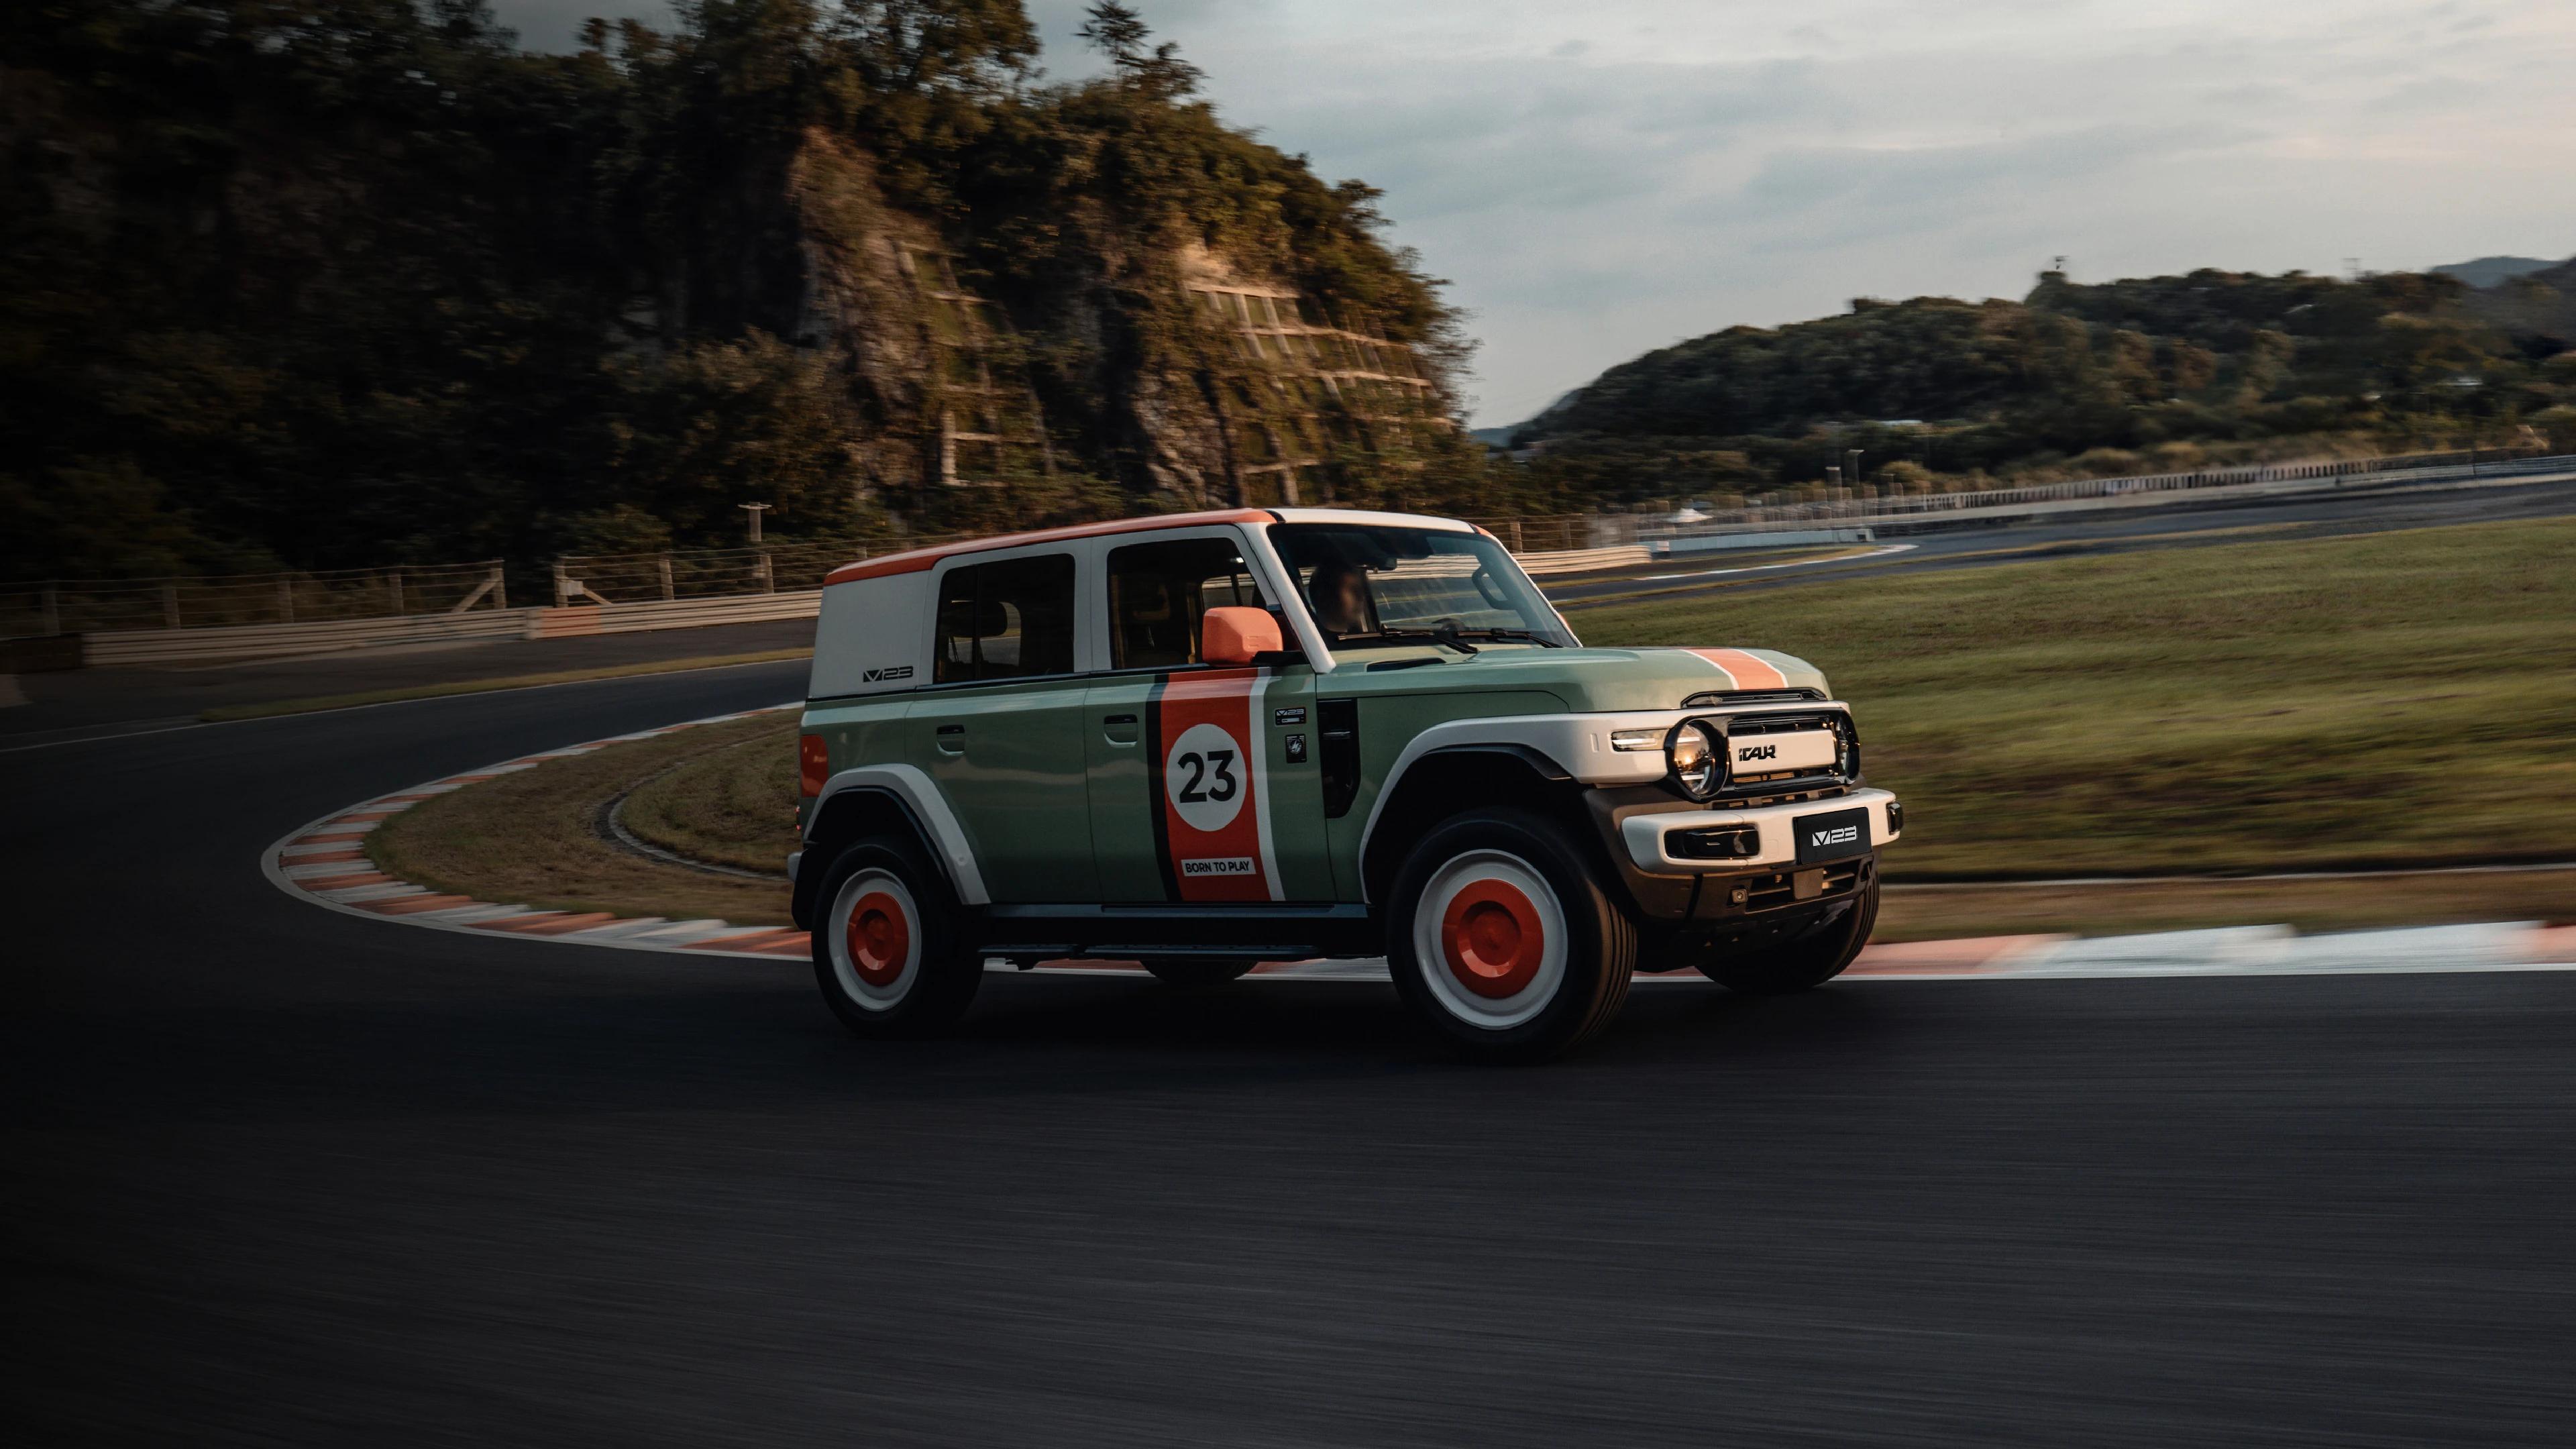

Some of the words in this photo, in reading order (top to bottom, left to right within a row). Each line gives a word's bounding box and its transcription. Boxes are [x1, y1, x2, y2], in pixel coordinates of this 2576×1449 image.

[863, 666, 914, 683] V23
[1178, 750, 1236, 803] 23
[1812, 825, 1857, 847] V23
[1185, 862, 1212, 873] BORN
[1214, 862, 1226, 872] TO
[1228, 861, 1249, 871] PLAY
